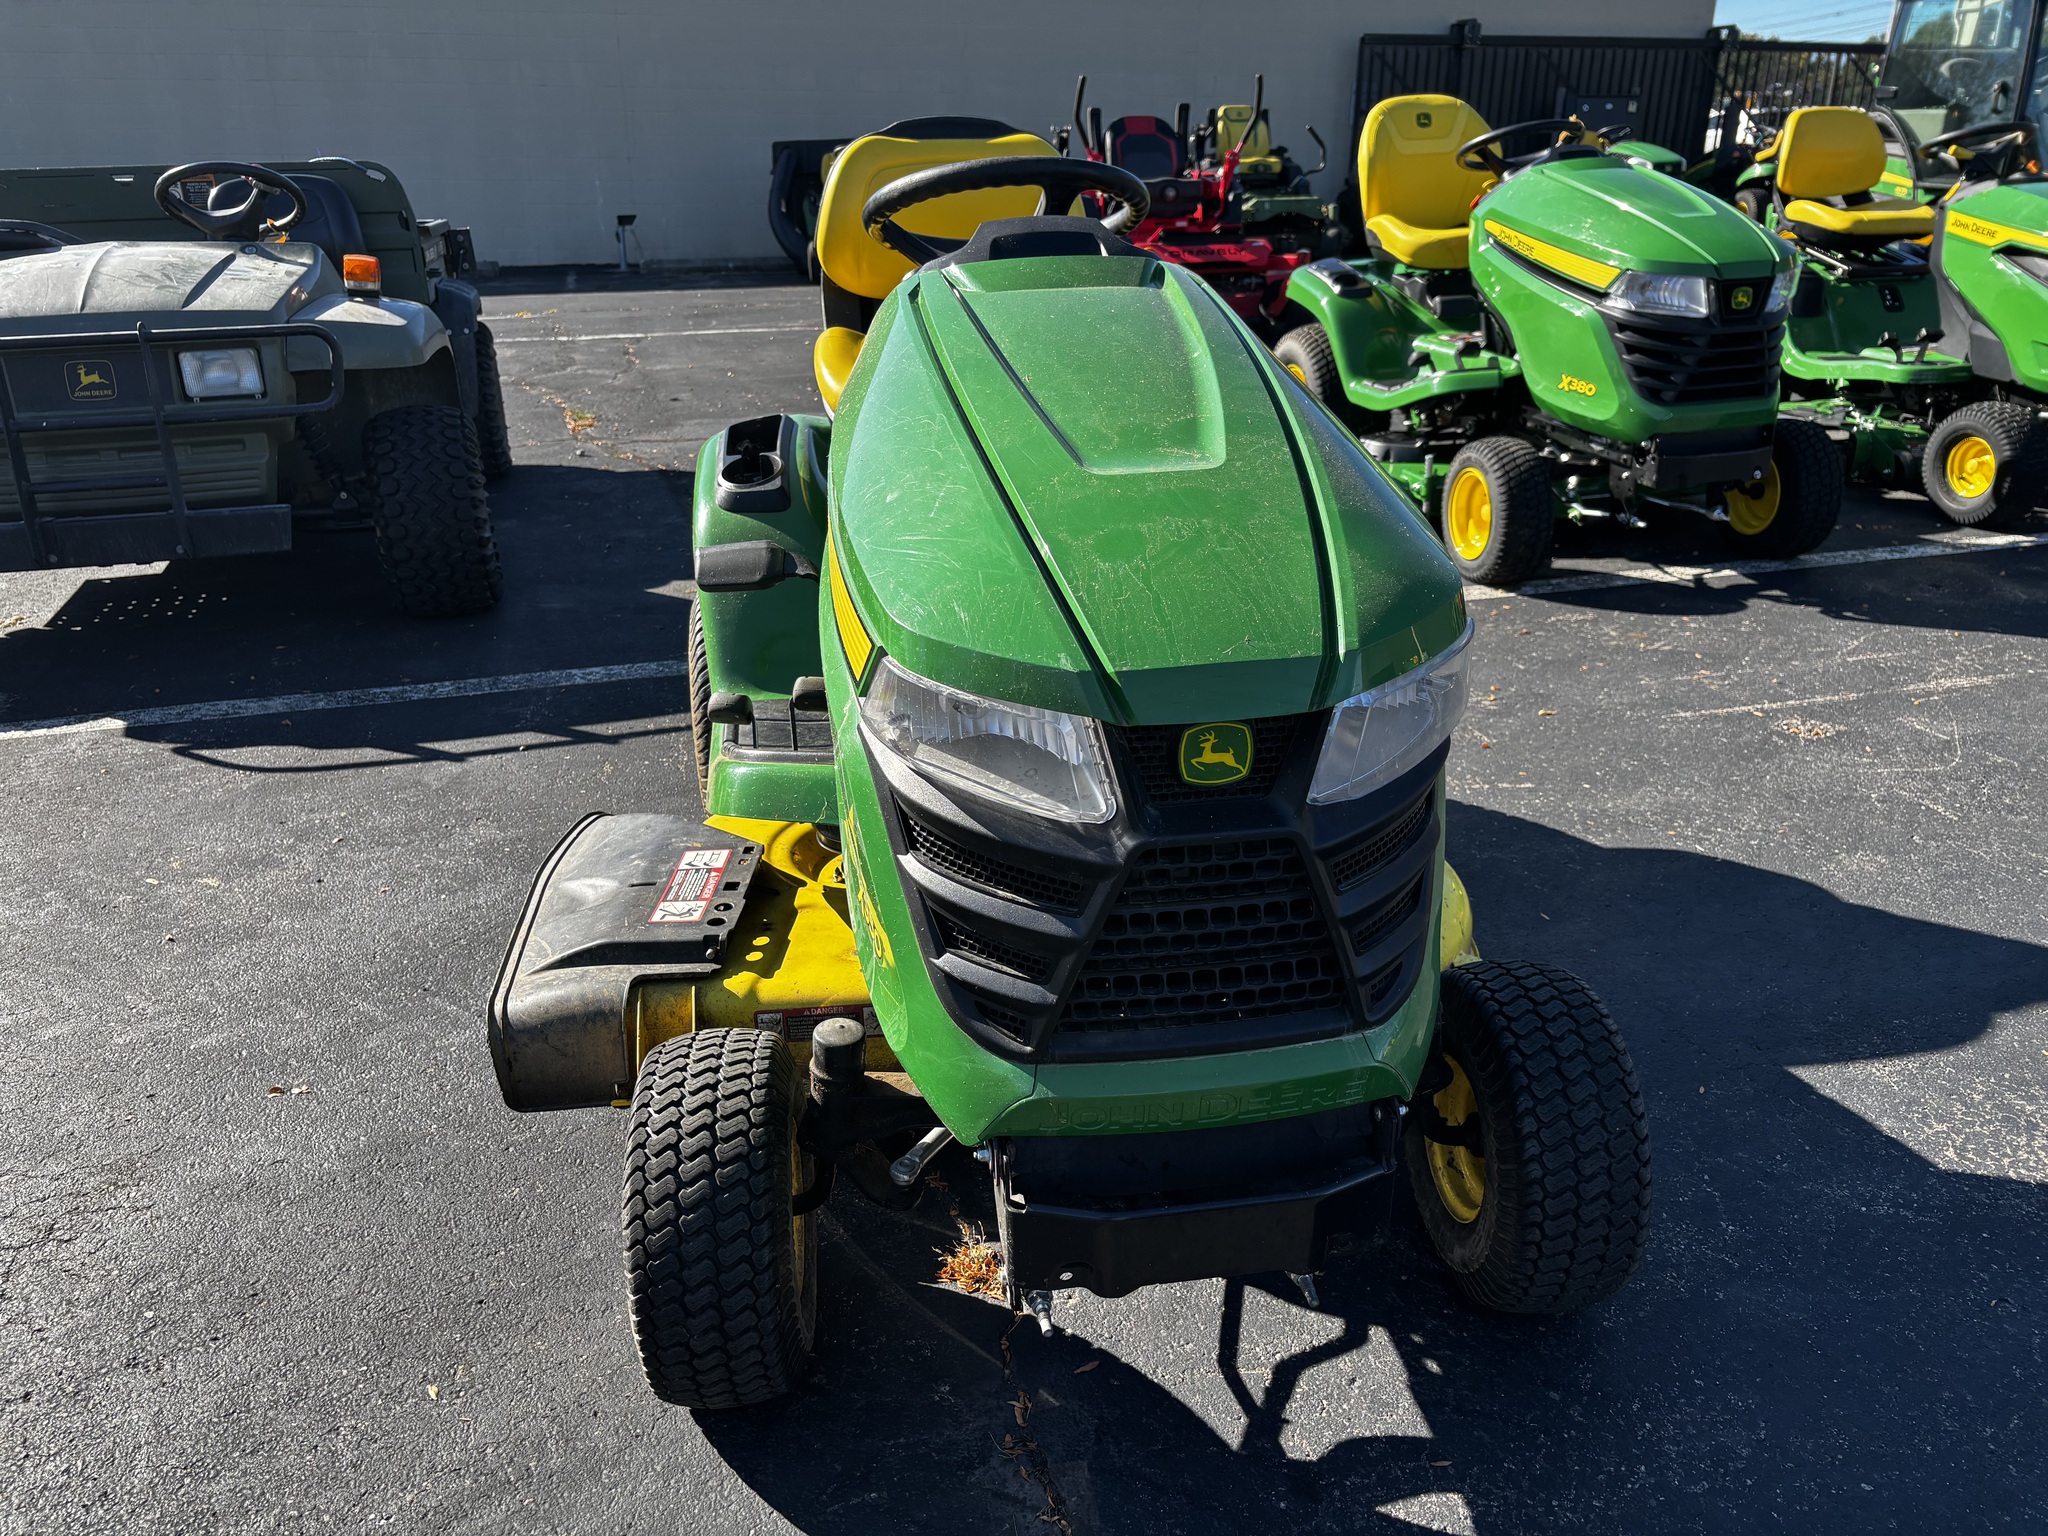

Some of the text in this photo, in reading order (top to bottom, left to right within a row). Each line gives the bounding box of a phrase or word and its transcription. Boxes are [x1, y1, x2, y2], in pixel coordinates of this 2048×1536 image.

[1951, 217, 1998, 239] JOHN DEERE
[1557, 373, 1597, 397] X380
[810, 1006, 845, 1016] DANGER
[1038, 1079, 1367, 1131] JOHN DEERE
